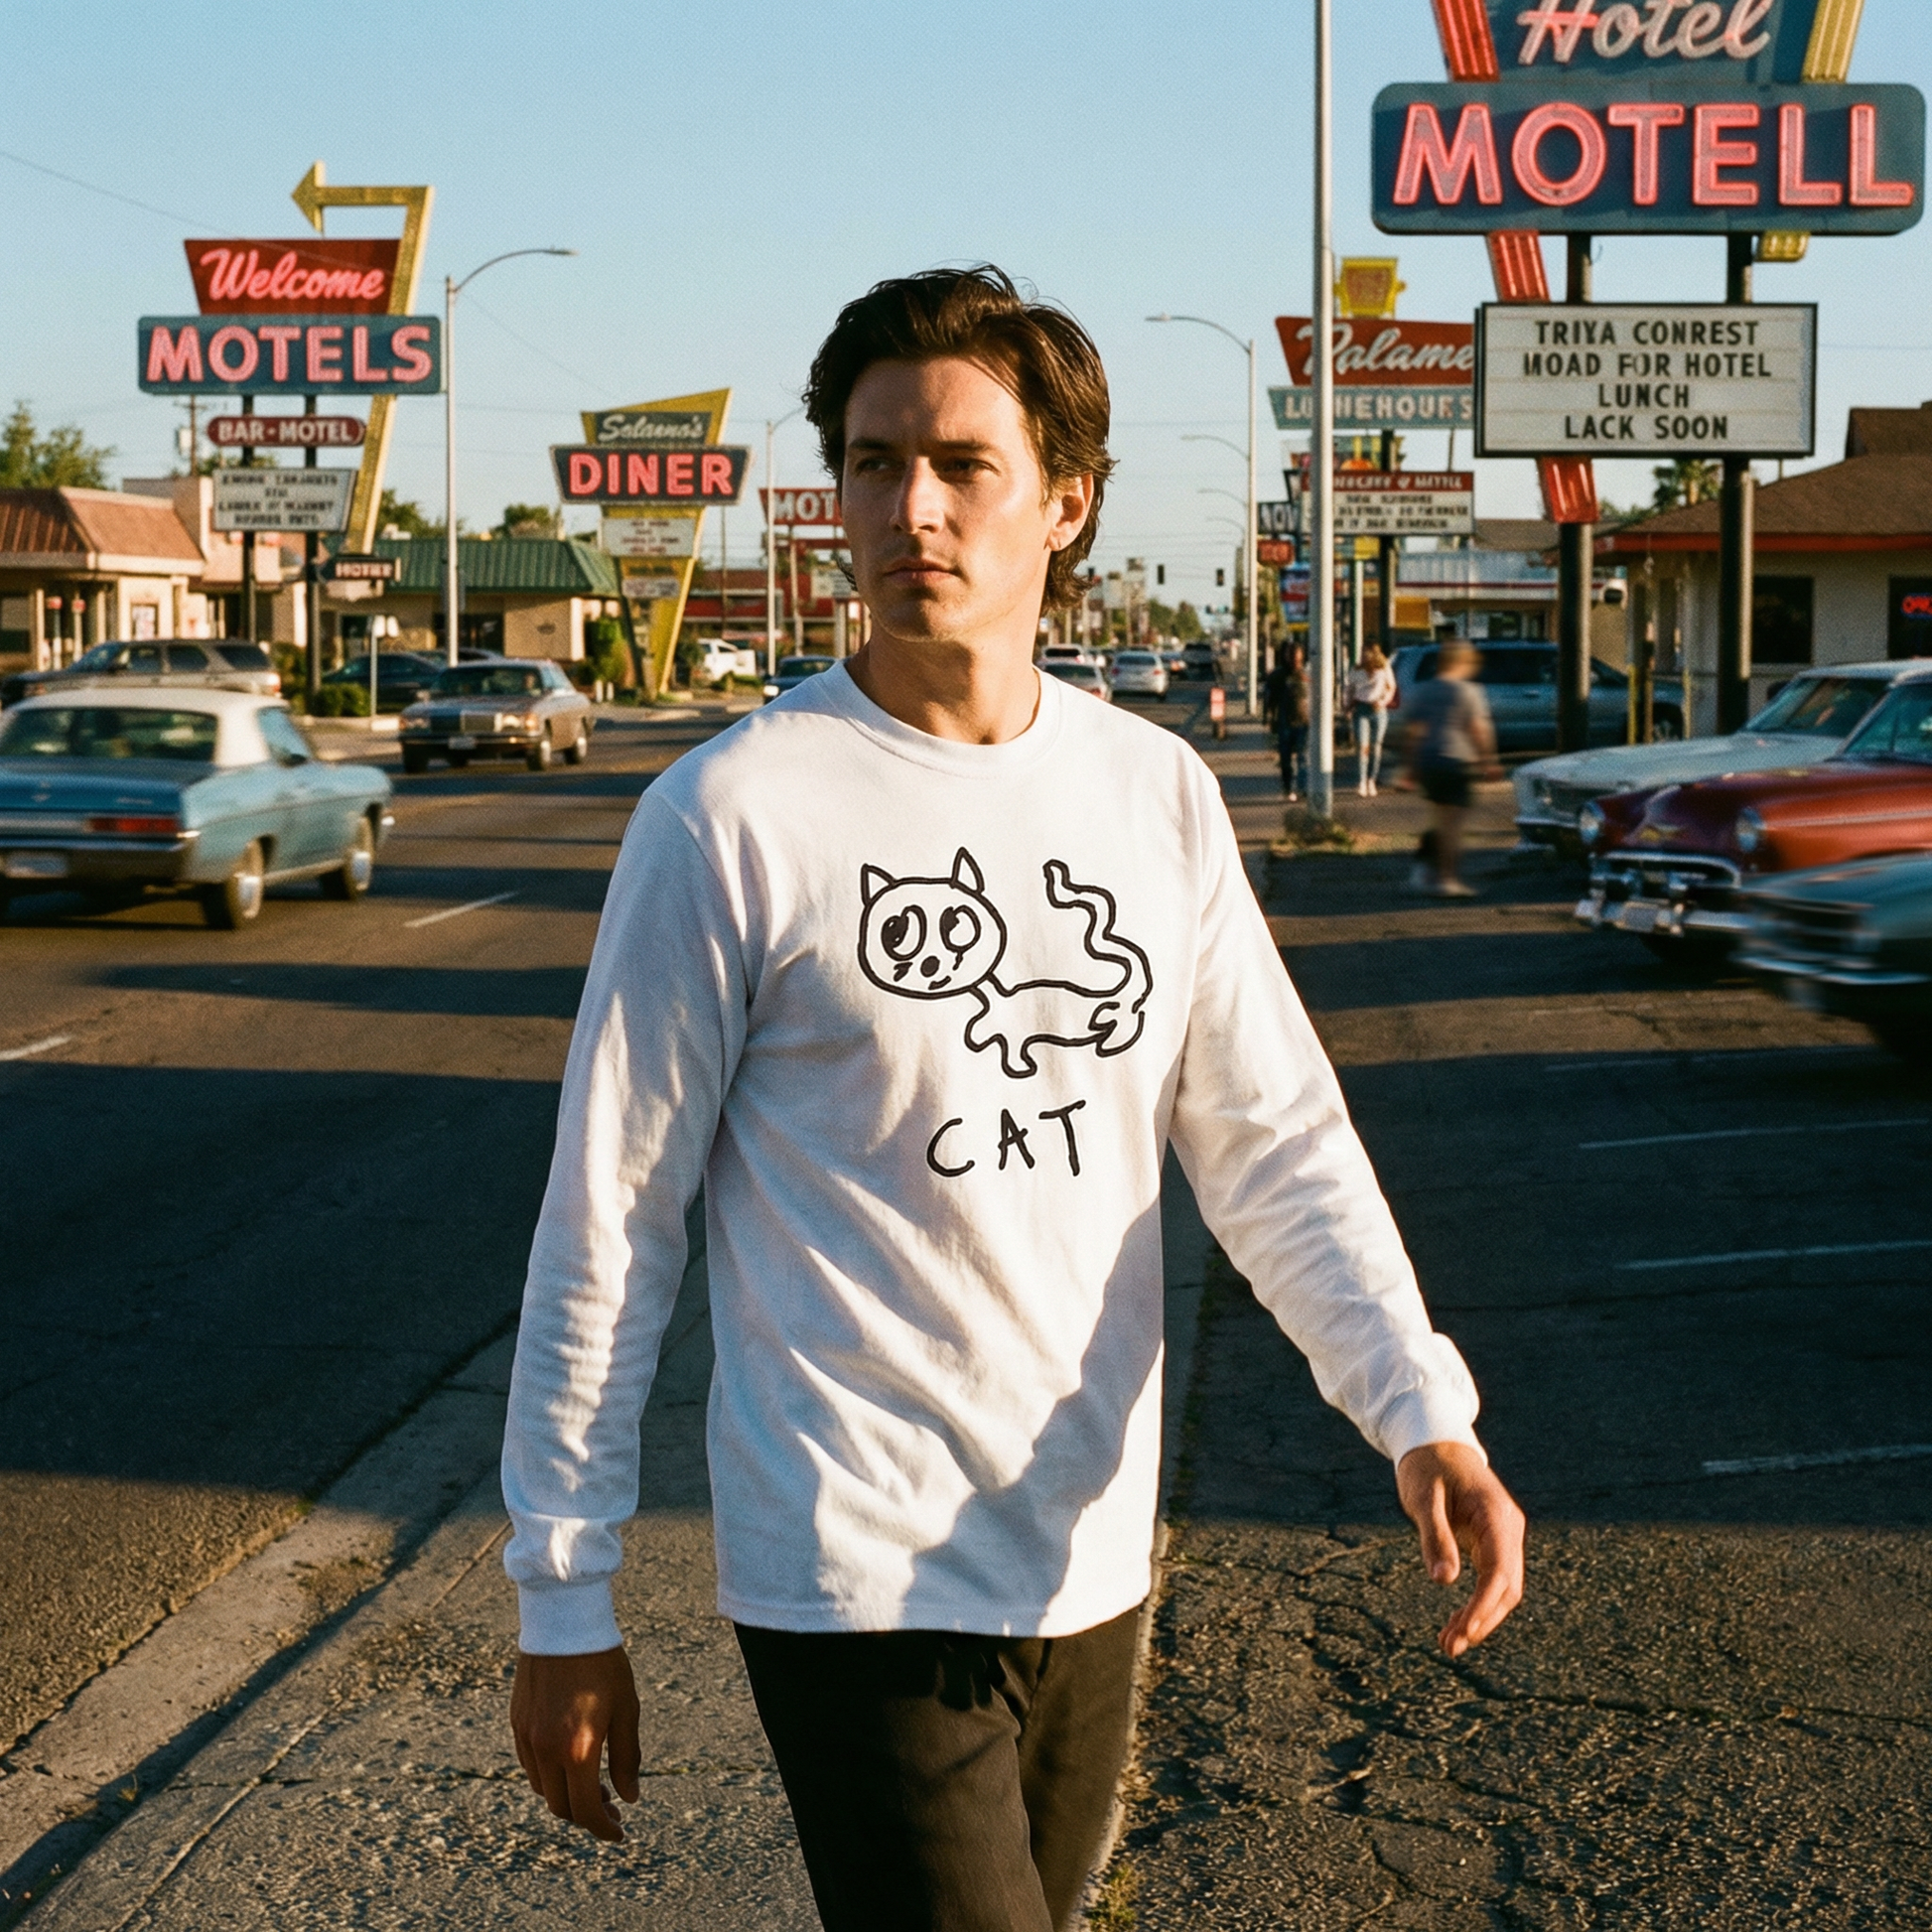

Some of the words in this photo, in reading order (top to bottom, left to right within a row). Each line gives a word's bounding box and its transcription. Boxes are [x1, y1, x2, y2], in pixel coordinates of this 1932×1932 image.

[1516, 0, 1773, 66] Hotel
[1393, 102, 1915, 207] MOTELL
[200, 248, 385, 301] Welcome
[146, 325, 434, 383] MOTELS
[1633, 321, 1759, 345] CONREST
[1687, 352, 1772, 377] HOTEL
[1598, 383, 1690, 408] LUNCH
[218, 420, 265, 442] BAR
[279, 420, 353, 442] MOTEL
[1565, 415, 1635, 440] LACK
[1655, 415, 1728, 440] SOON
[569, 453, 734, 496] DINER
[926, 1099, 1087, 1177] CAT
